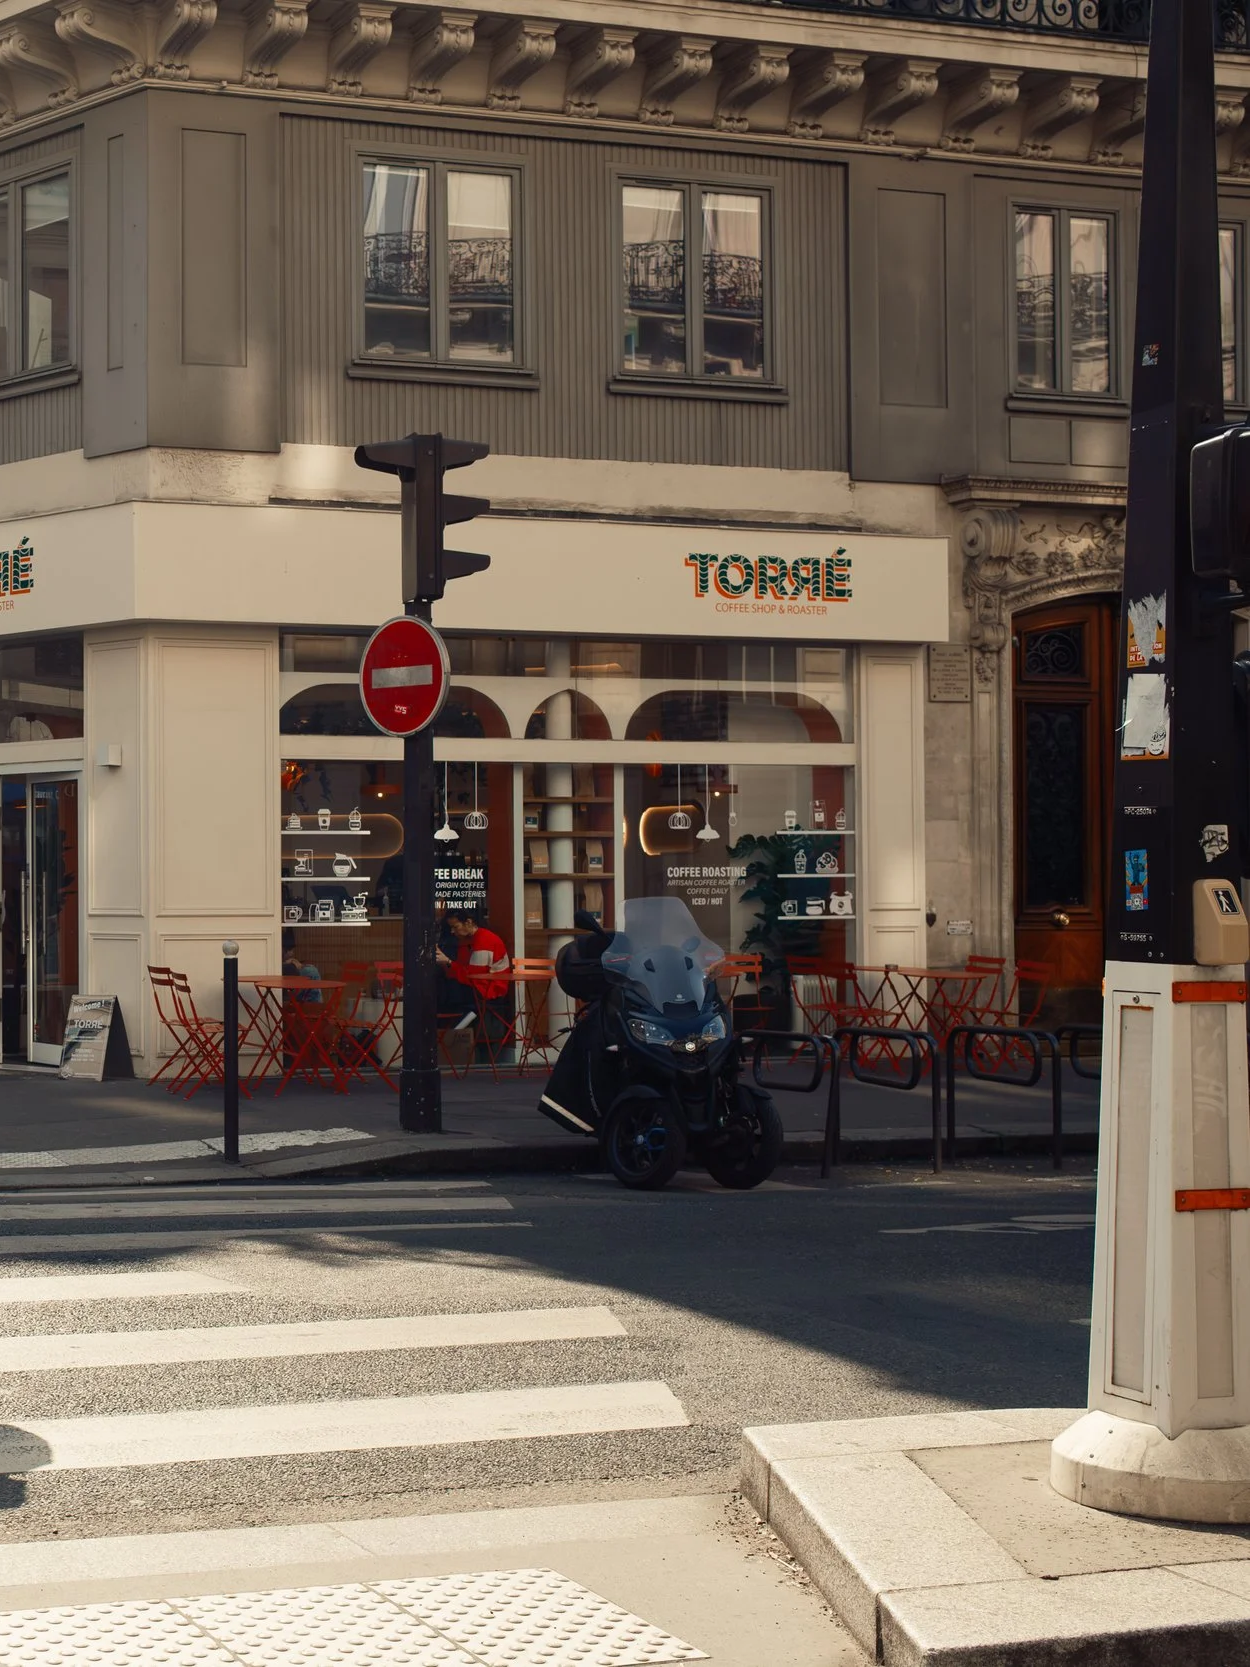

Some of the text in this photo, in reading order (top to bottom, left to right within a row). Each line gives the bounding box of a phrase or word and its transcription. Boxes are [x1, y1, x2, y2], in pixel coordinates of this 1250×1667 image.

[685, 546, 853, 603] TORRÉ
[715, 602, 827, 616] COFFEE SHOP & ROASTER
[434, 868, 484, 879] FEE BREAK
[667, 867, 747, 878] COFFEE ROASTING
[435, 881, 485, 889] ORIGIN COFFEE
[452, 890, 487, 898] PASTERIES
[446, 901, 463, 909] TAKE
[463, 901, 477, 909] OUT
